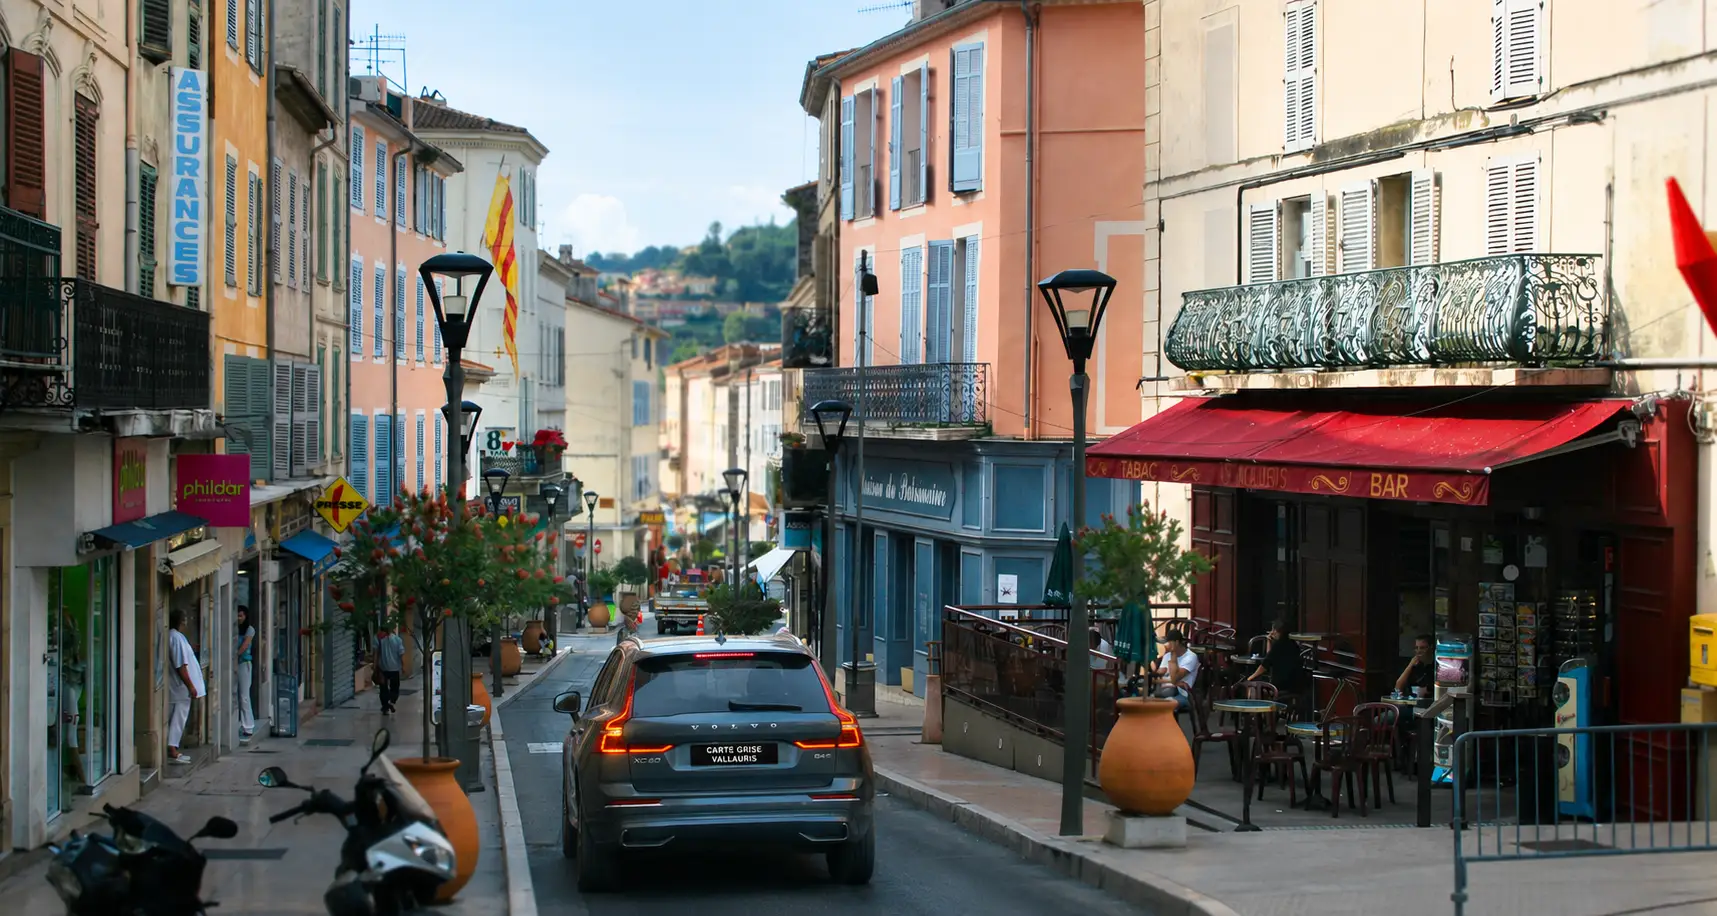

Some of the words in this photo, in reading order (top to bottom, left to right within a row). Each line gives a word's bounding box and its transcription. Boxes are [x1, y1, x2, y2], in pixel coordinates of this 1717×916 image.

[174, 70, 201, 283] ASSURANCES
[1121, 460, 1157, 479] TABAC
[1370, 473, 1409, 498] BAR
[184, 479, 244, 499] phildar
[316, 500, 362, 509] PRESSE
[706, 746, 734, 754] CARTE
[736, 745, 762, 753] GRISE
[711, 755, 757, 763] VALLAURIS
